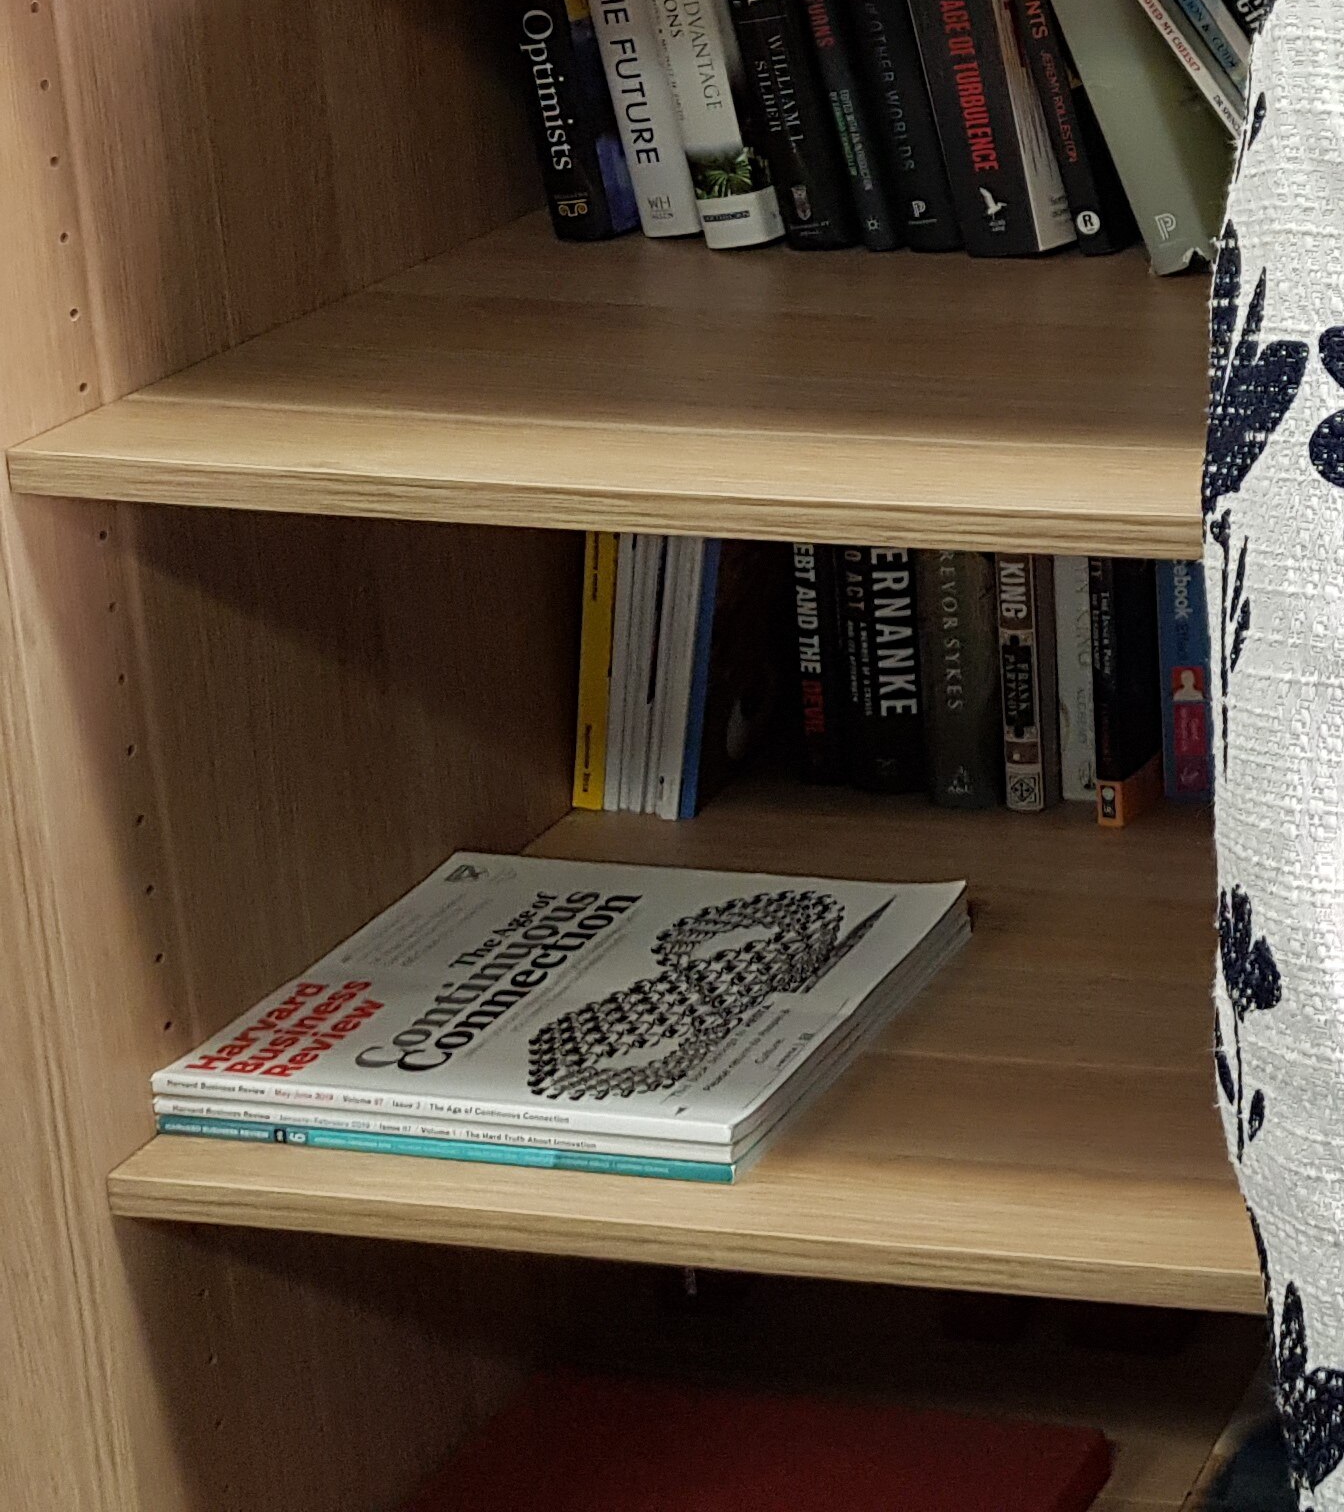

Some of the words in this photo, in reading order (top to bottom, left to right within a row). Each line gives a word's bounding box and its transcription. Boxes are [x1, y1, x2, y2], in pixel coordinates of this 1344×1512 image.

[519, 9, 576, 172] Optimists
[608, 38, 662, 167] FUTURE
[953, 61, 1000, 173] TURBULENCE
[796, 584, 818, 631] AND
[1000, 561, 1028, 621] KING
[798, 632, 822, 676] THE
[184, 981, 330, 1072] Harvard
[354, 890, 601, 1068] Continuous
[397, 893, 644, 1072] Connection
[221, 980, 373, 1076] Business
[259, 998, 386, 1078] Review
